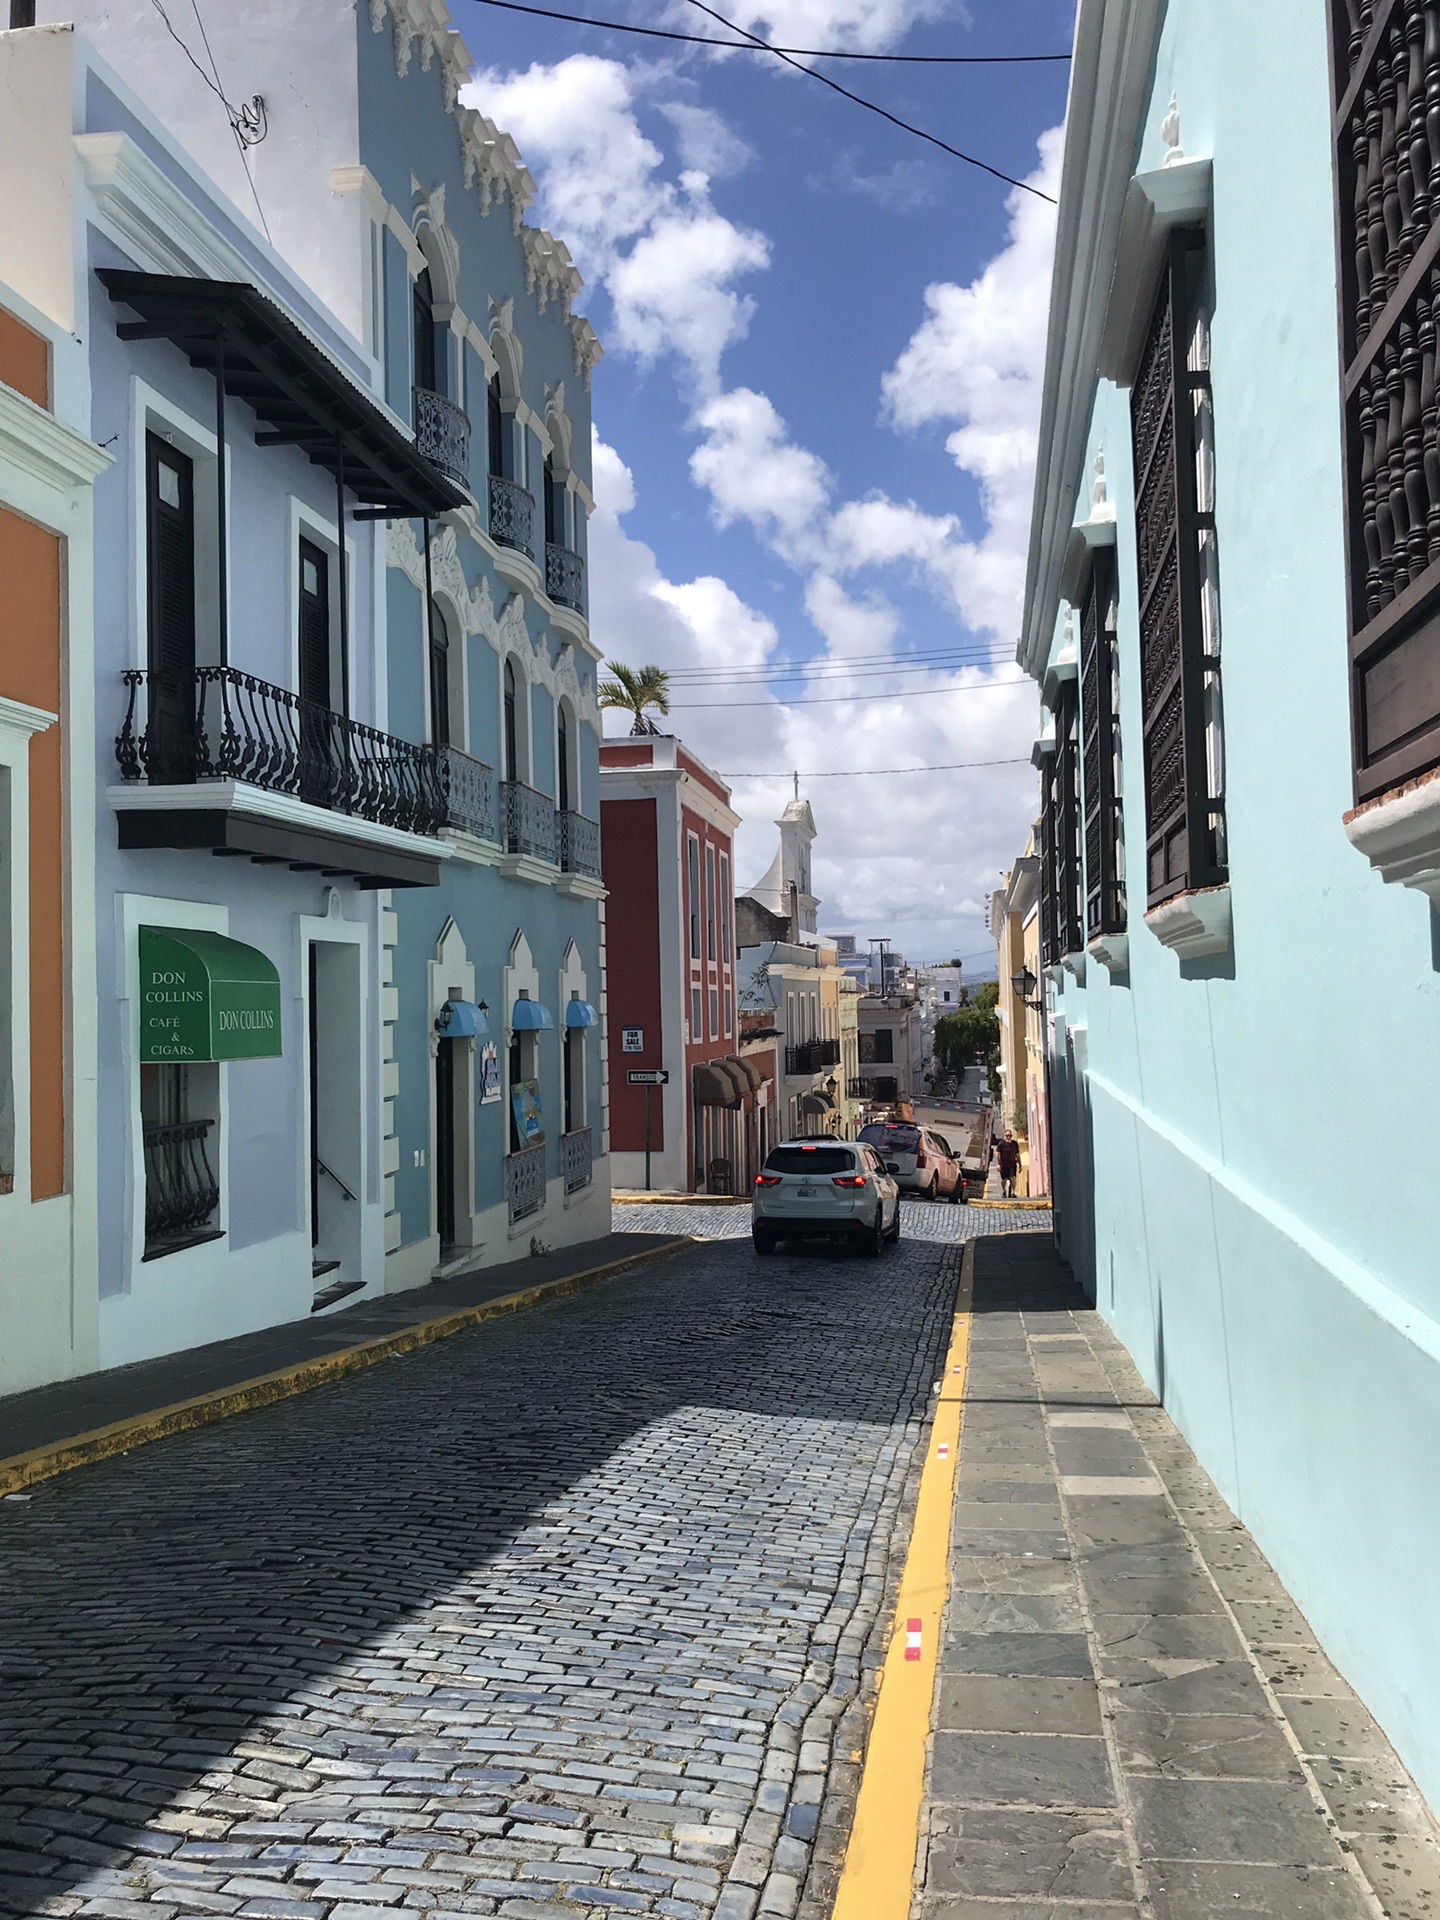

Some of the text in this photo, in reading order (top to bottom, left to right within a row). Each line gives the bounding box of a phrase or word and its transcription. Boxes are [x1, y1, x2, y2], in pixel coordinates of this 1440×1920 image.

[152, 972, 186, 984] DON
[145, 991, 203, 1003] COLLINS
[220, 1010, 274, 1031] DON COLLINS
[171, 1032, 180, 1042] &
[150, 1045, 194, 1055] CIGARS
